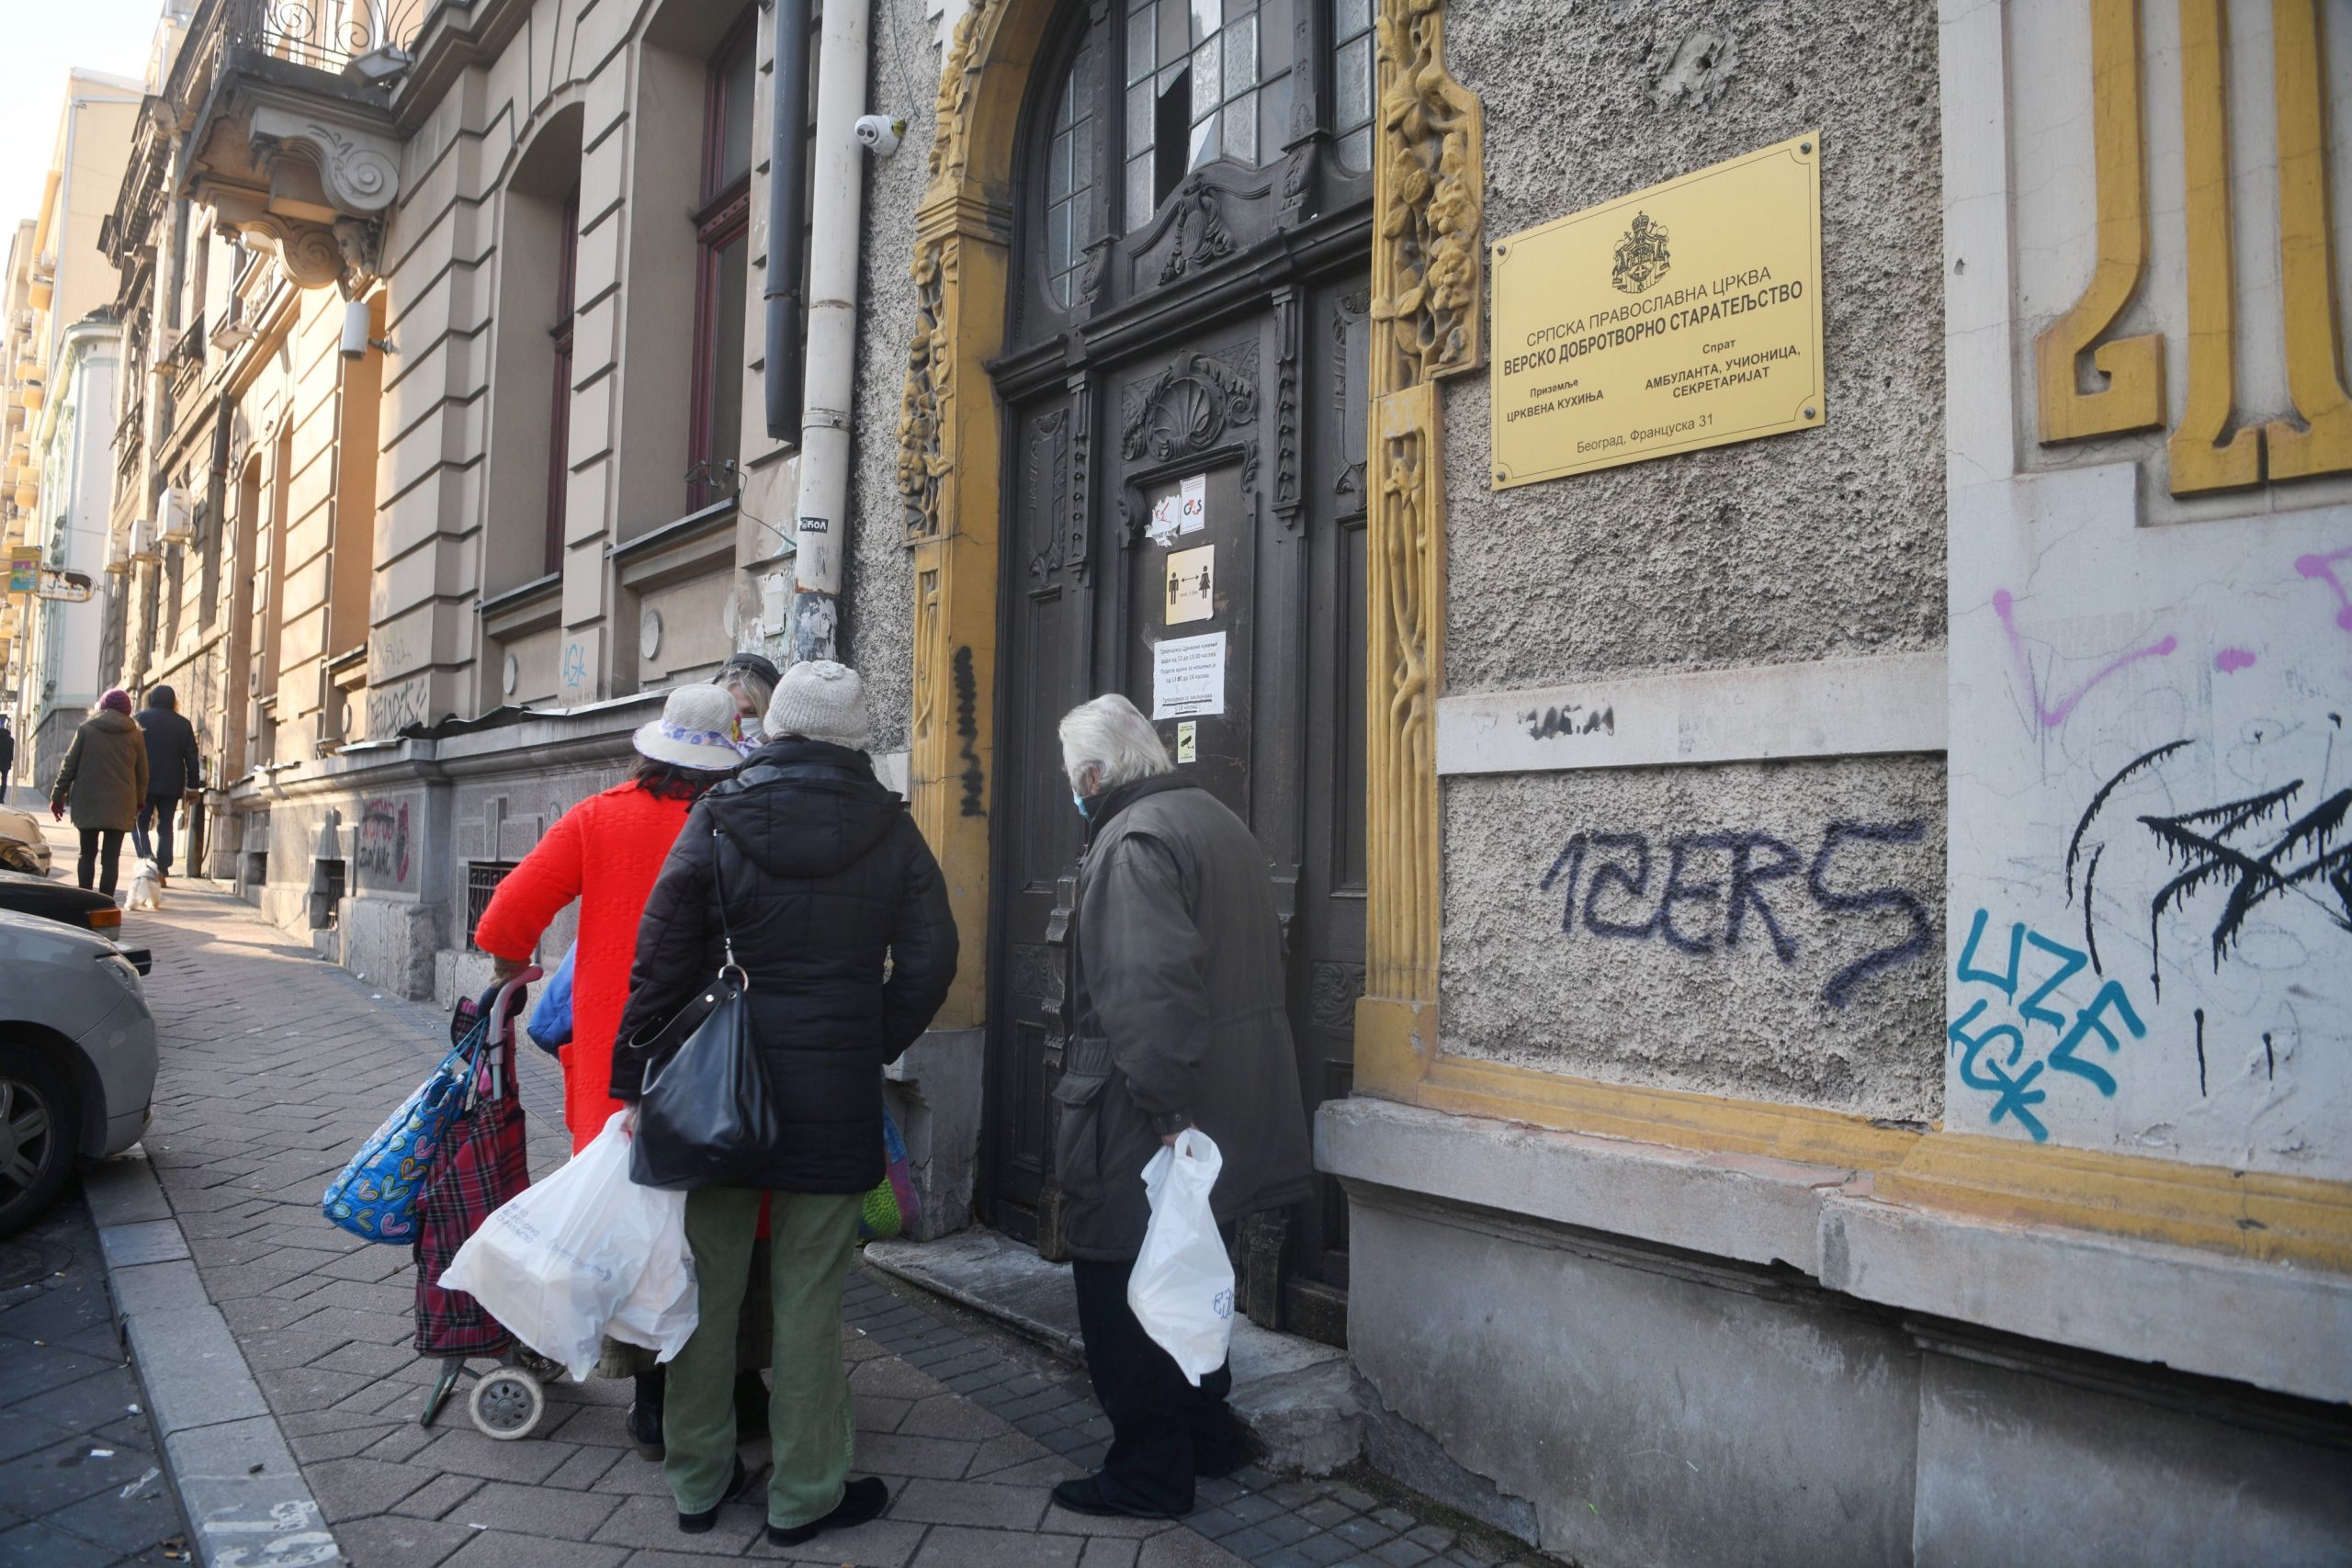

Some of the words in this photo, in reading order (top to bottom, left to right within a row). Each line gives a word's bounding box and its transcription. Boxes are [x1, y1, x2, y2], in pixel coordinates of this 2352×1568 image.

[1527, 319, 1585, 346] СРПСКА
[1589, 284, 1708, 329] ПРАВОСЛАВНА
[1713, 266, 1771, 298] ЦРКВА
[1504, 347, 1555, 376] ВЕРСКО
[1559, 317, 1666, 364] ДОБРОТВОРНО
[1670, 280, 1803, 331] СТАРАТЕЉСТВО
[1702, 340, 1736, 355] Спрат
[1645, 363, 1721, 389] АМБУЛАНТА,
[1725, 344, 1801, 371] УЧИОНИЦА,
[1673, 367, 1770, 398] СЕКРЕТАРИЈАТ
[1531, 378, 1577, 397] Приземље
[1507, 401, 1555, 422] ЦРКВЕНА
[1557, 390, 1603, 410] КУХИЊА
[1577, 434, 1626, 454] Београд,
[1631, 420, 1695, 442] Француска
[1699, 413, 1713, 426] 31
